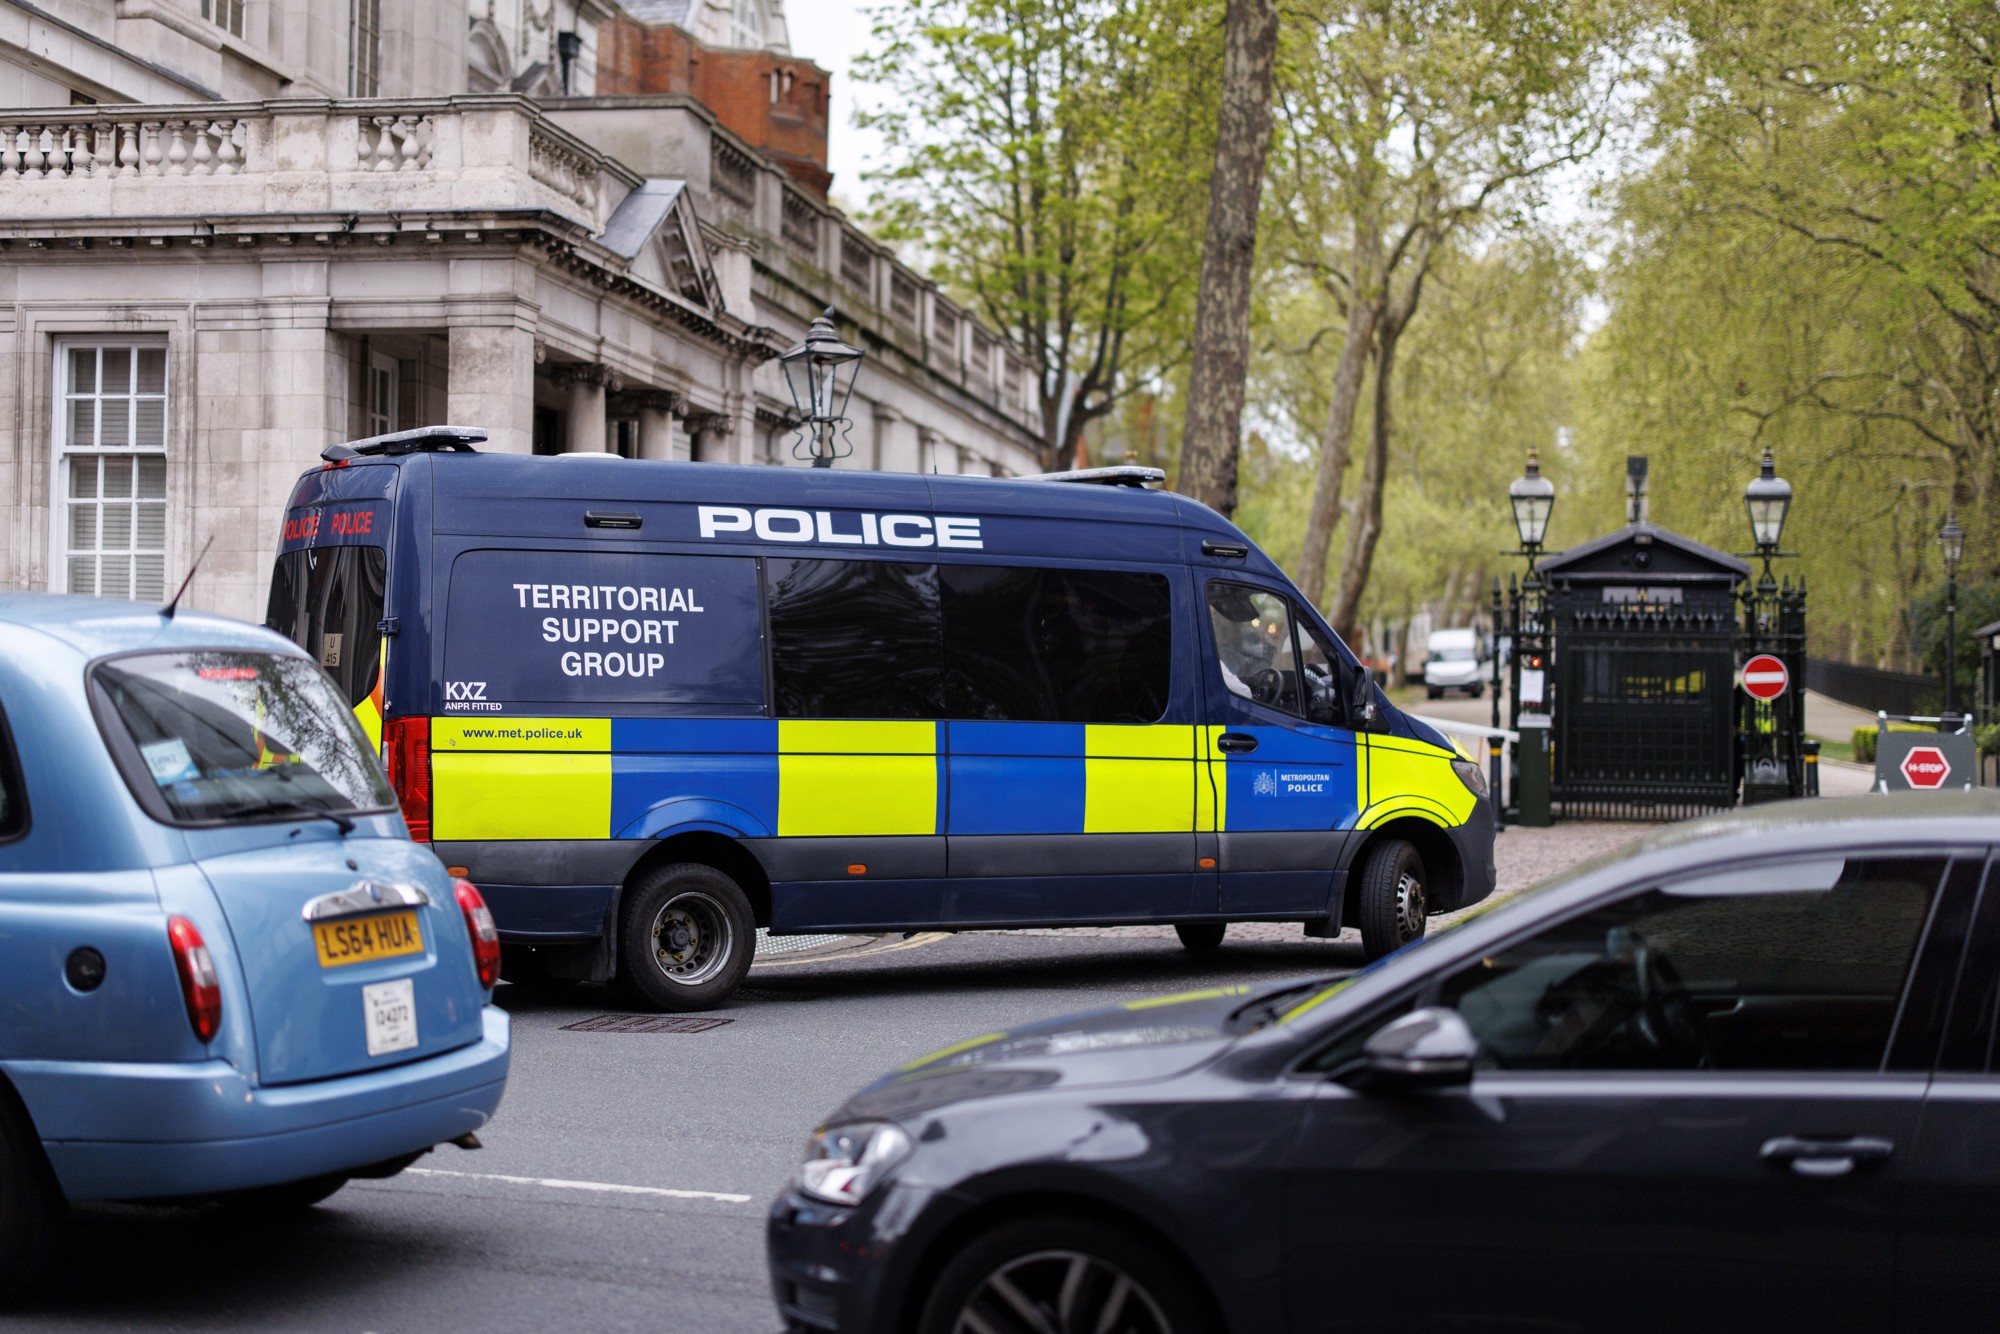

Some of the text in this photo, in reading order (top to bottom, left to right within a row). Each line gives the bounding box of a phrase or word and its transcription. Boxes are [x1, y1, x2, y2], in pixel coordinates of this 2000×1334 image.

[331, 511, 374, 535] POLICE
[698, 506, 983, 549] POLICE
[513, 583, 704, 612] TERRITORIAL
[542, 617, 679, 644] SUPPORT
[330, 636, 336, 649] U
[325, 652, 337, 665] 415
[561, 651, 665, 677] GROUP
[445, 681, 487, 700] KXZ
[445, 702, 502, 711] ANPR FITTED
[462, 727, 583, 741] www.met.police.uk
[1908, 763, 1943, 773] H-STOP
[1288, 784, 1323, 792] POLICE
[320, 916, 415, 959] LS64 HUA
